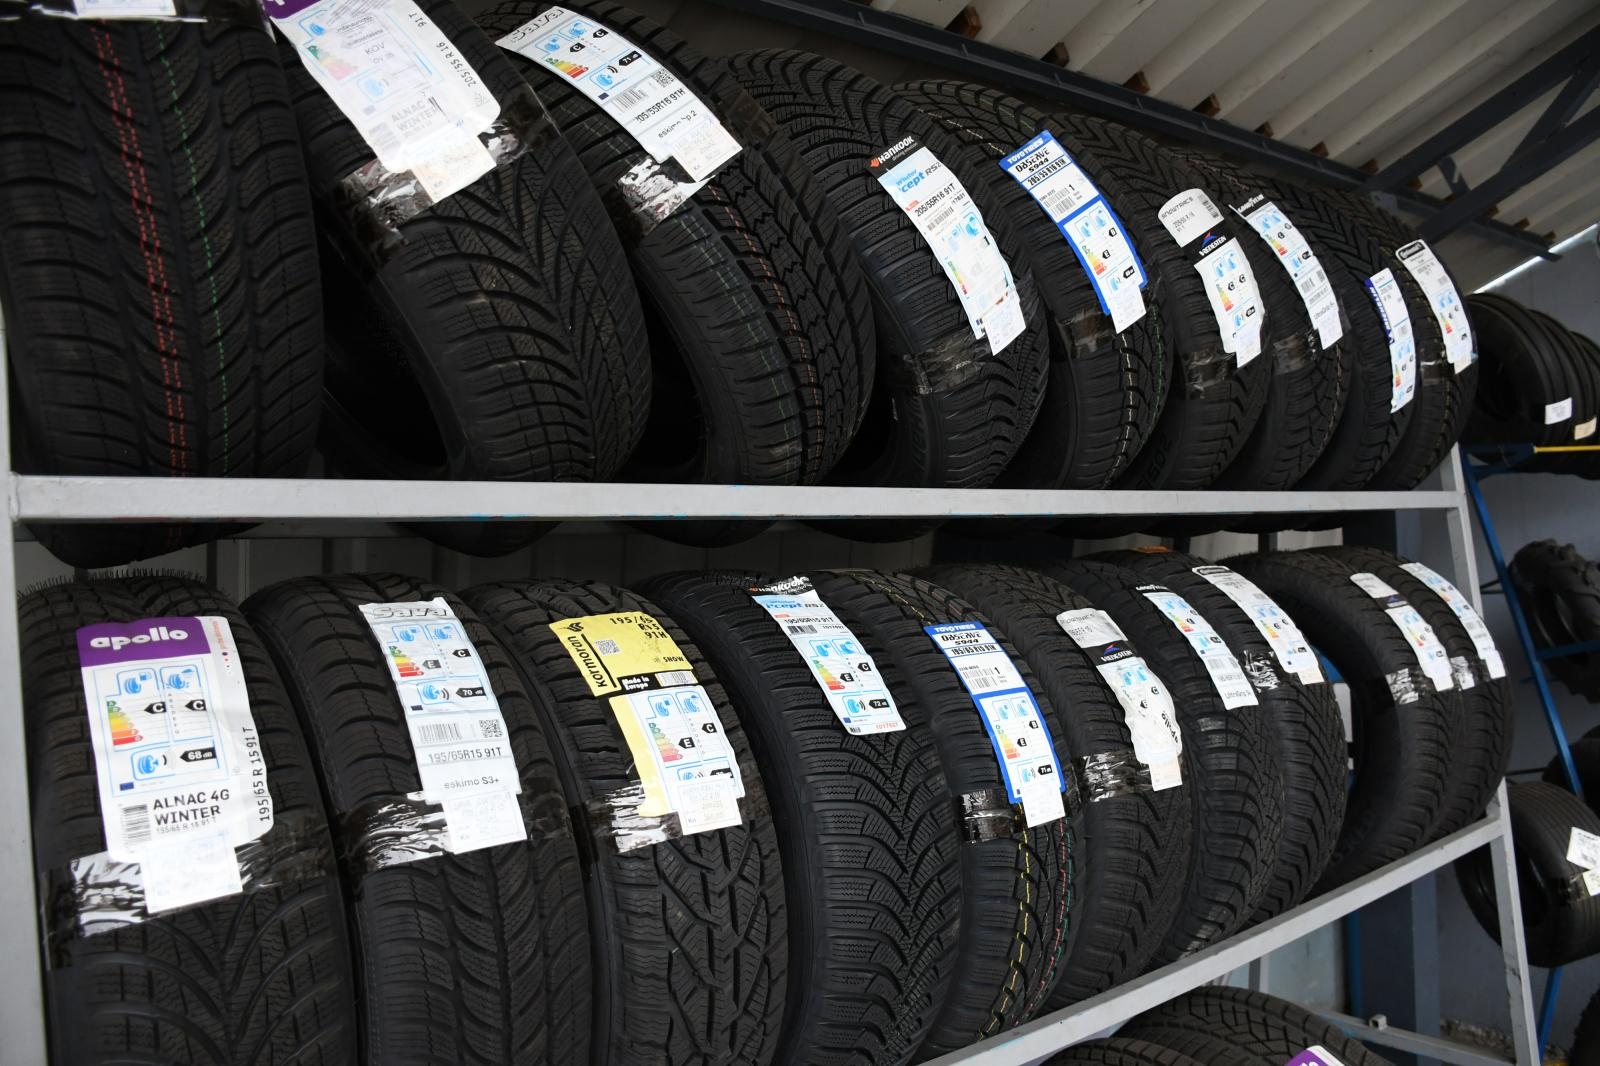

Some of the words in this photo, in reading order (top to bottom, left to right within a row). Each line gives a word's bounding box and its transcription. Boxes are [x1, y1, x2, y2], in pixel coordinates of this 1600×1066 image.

[90, 626, 189, 651] apollo
[621, 676, 641, 684] Made
[625, 682, 649, 691] Europe
[246, 736, 259, 751] 91
[188, 750, 202, 761] 68
[250, 751, 263, 768] 15
[428, 747, 483, 764] 195/65R15
[484, 746, 502, 758] 91T
[252, 767, 264, 777] R
[153, 791, 208, 812] ALNAC
[211, 788, 231, 802] 4G
[253, 778, 271, 823] 195/65
[155, 804, 222, 827] WINTER
